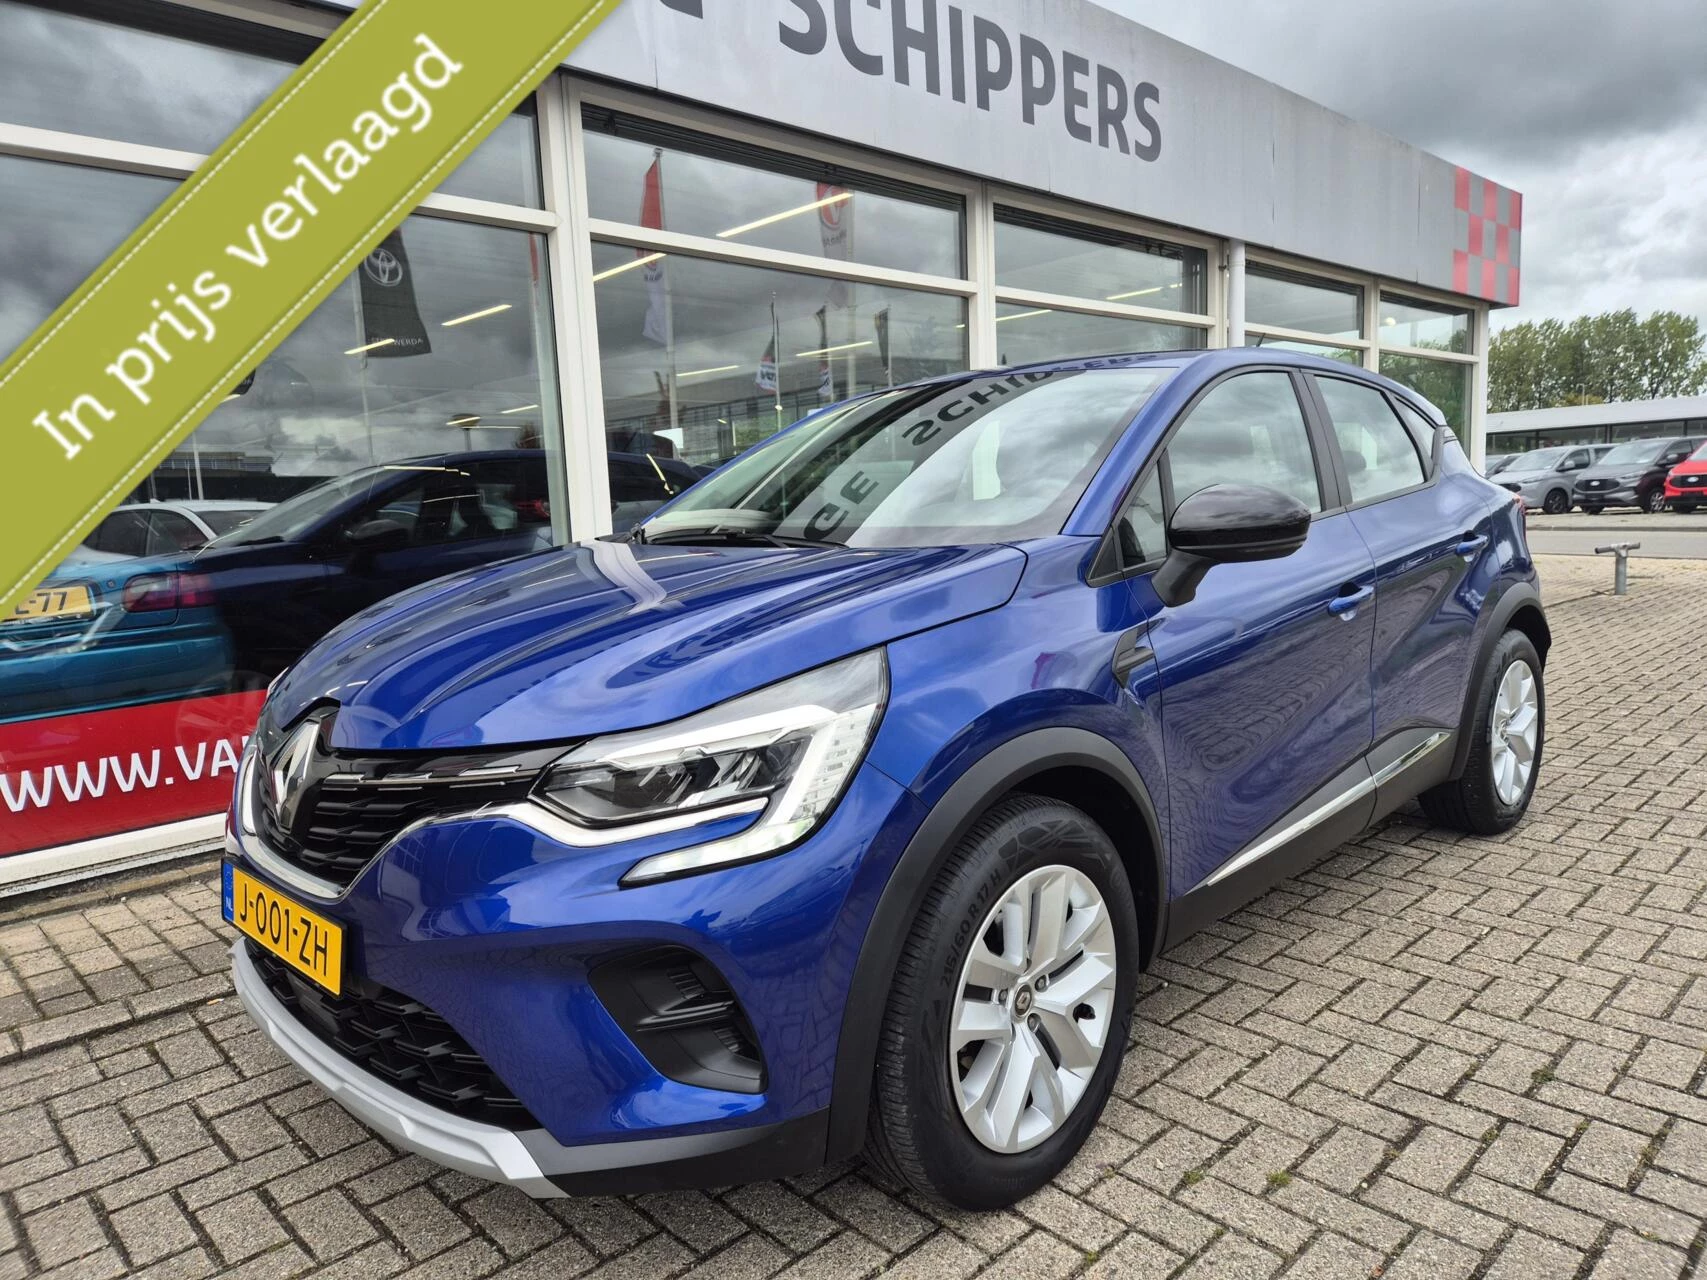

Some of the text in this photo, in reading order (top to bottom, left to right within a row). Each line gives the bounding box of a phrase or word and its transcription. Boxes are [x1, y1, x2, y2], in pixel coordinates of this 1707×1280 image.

[778, 0, 1162, 163] SCHIPPERS
[0, 736, 250, 813] WWW.VA
[240, 883, 328, 977] J-001-ZH
[941, 920, 971, 988] 215/60
